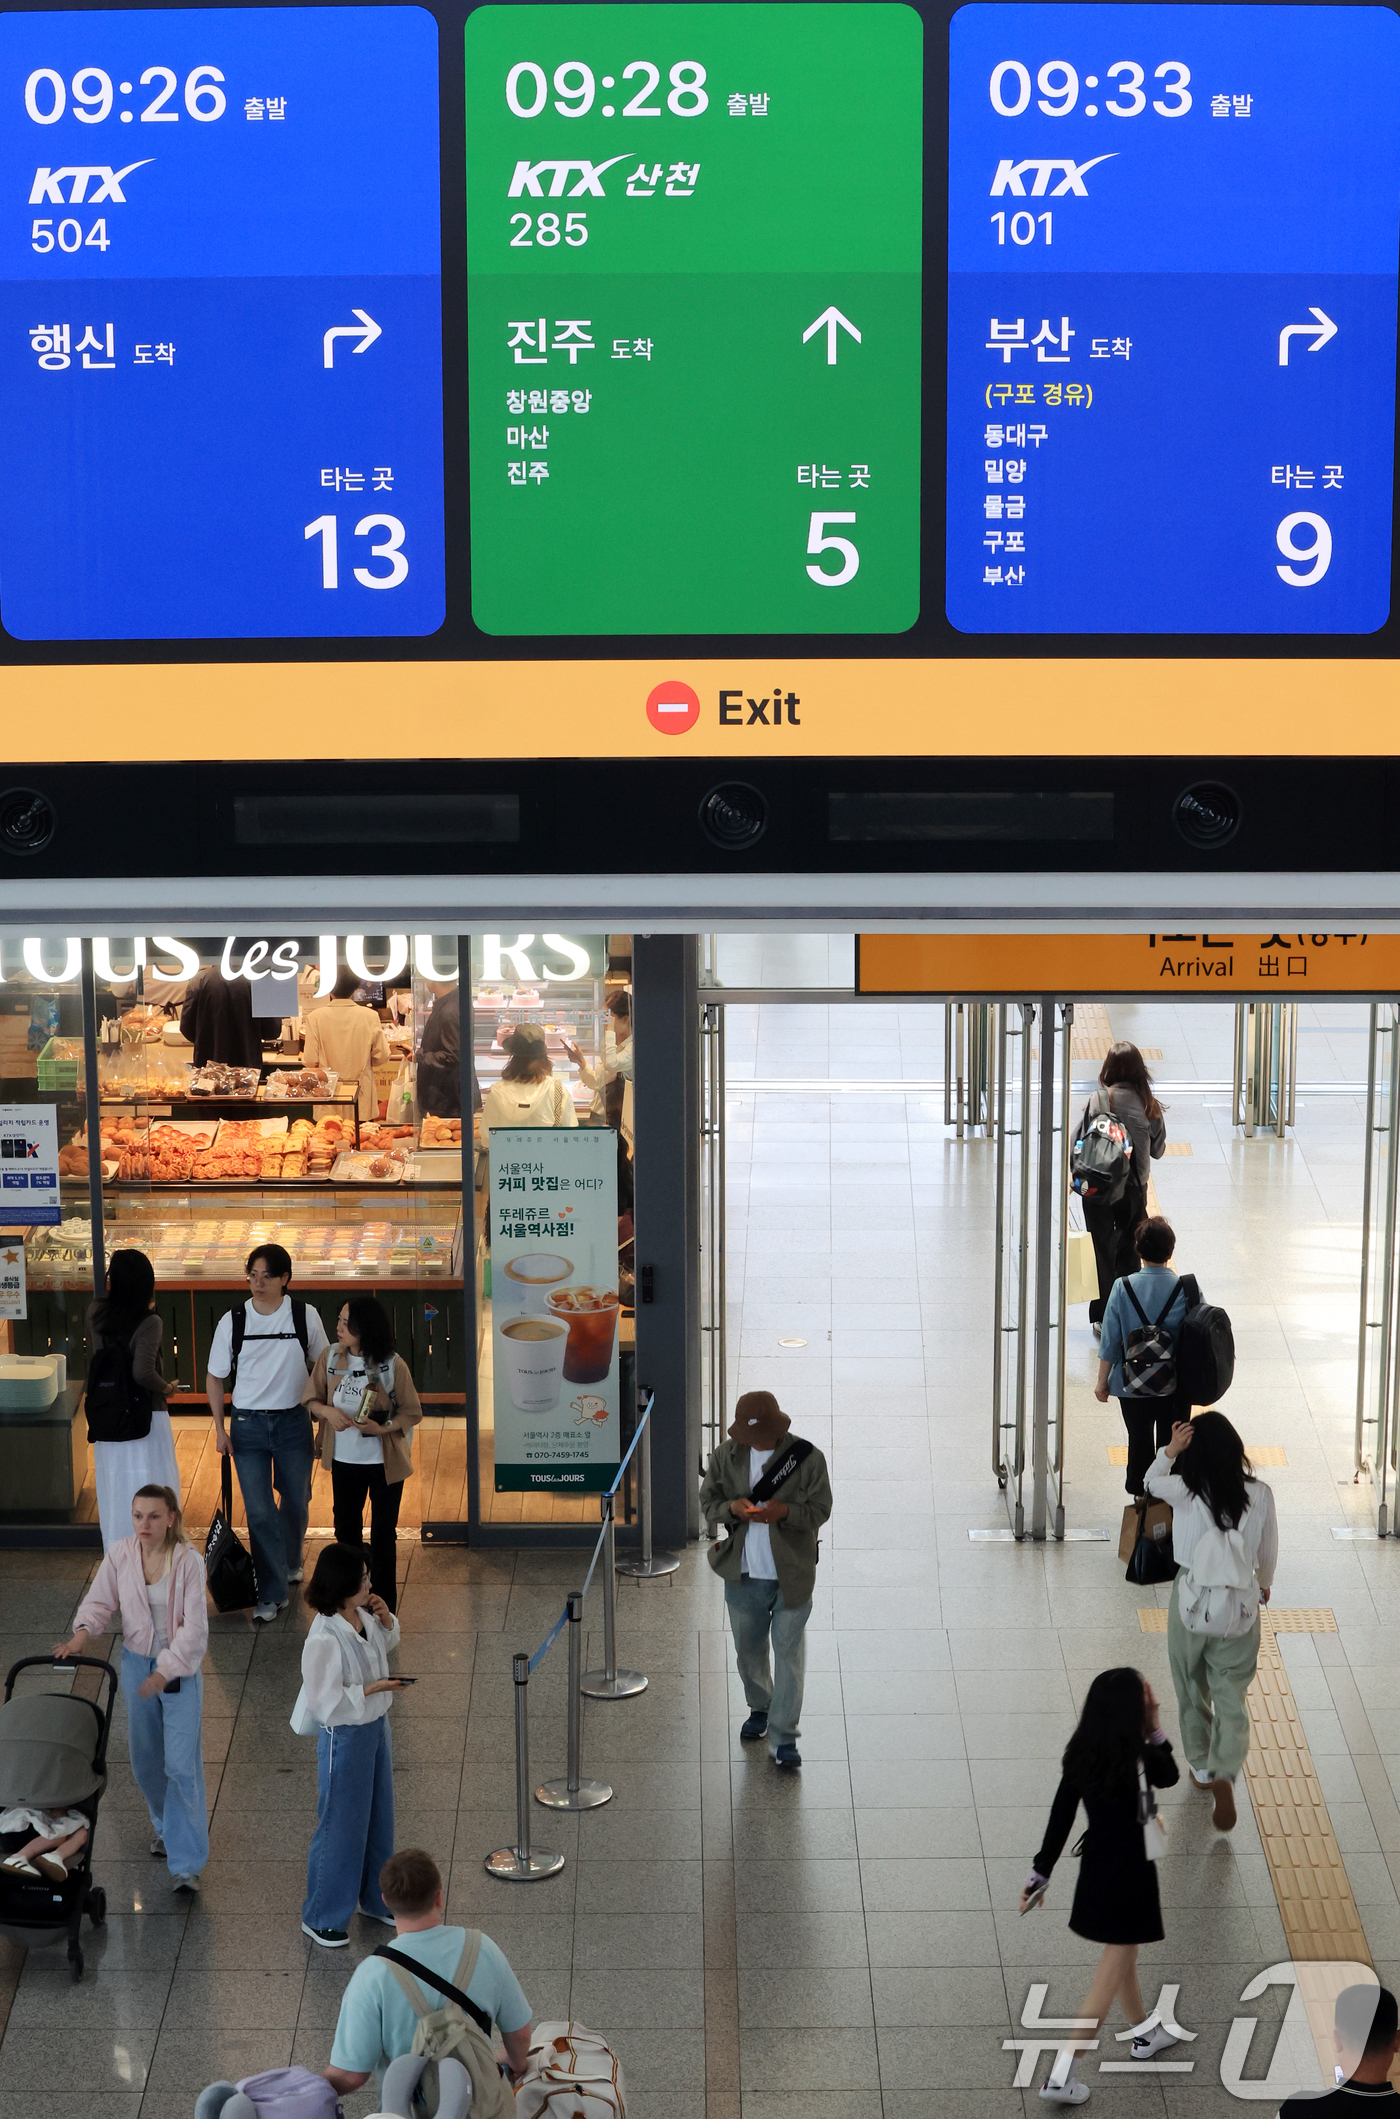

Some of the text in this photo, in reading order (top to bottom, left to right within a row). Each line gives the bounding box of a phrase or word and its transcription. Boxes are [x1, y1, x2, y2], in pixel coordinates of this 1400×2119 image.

[25, 66, 287, 124] 09:26 출발
[506, 61, 770, 118] 09:28 출발
[990, 60, 1253, 117] 09:33 출발
[29, 159, 156, 204] KTX
[508, 153, 700, 197] KTX 산천
[990, 153, 1120, 196] KTX
[31, 219, 111, 253] 504
[509, 213, 589, 247] 285
[990, 212, 1053, 245] 101
[29, 323, 176, 370] 행신 도착
[507, 318, 654, 364] 진주 도착
[985, 317, 1133, 364] 부산 도착
[506, 389, 592, 415] 창원중앙
[985, 383, 1093, 409] (구포 경유)
[507, 425, 550, 450] 마산
[983, 424, 1049, 448] 동대구
[320, 467, 394, 492] 타는 곳
[507, 461, 550, 486] 진주
[797, 464, 871, 489] 타는 곳
[984, 459, 1027, 483] 밀양
[1271, 465, 1344, 489] 타는 곳
[983, 495, 1026, 519] 물금
[304, 514, 409, 590] 13
[805, 512, 860, 587] 5
[983, 531, 1026, 555] 구포
[1275, 512, 1333, 587] 9
[983, 565, 1026, 586] 부산
[719, 689, 801, 725] Exit
[0, 934, 590, 998] OUS les JOURS
[1159, 955, 1308, 977] Arrival 出口
[498, 1162, 544, 1175] 서울역사
[498, 1176, 604, 1192] 커피 맛집은 어디?
[499, 1207, 551, 1221] 뚜레쥬르
[499, 1222, 574, 1238] 서울역사점!
[534, 1451, 590, 1459] 070-7459-1745
